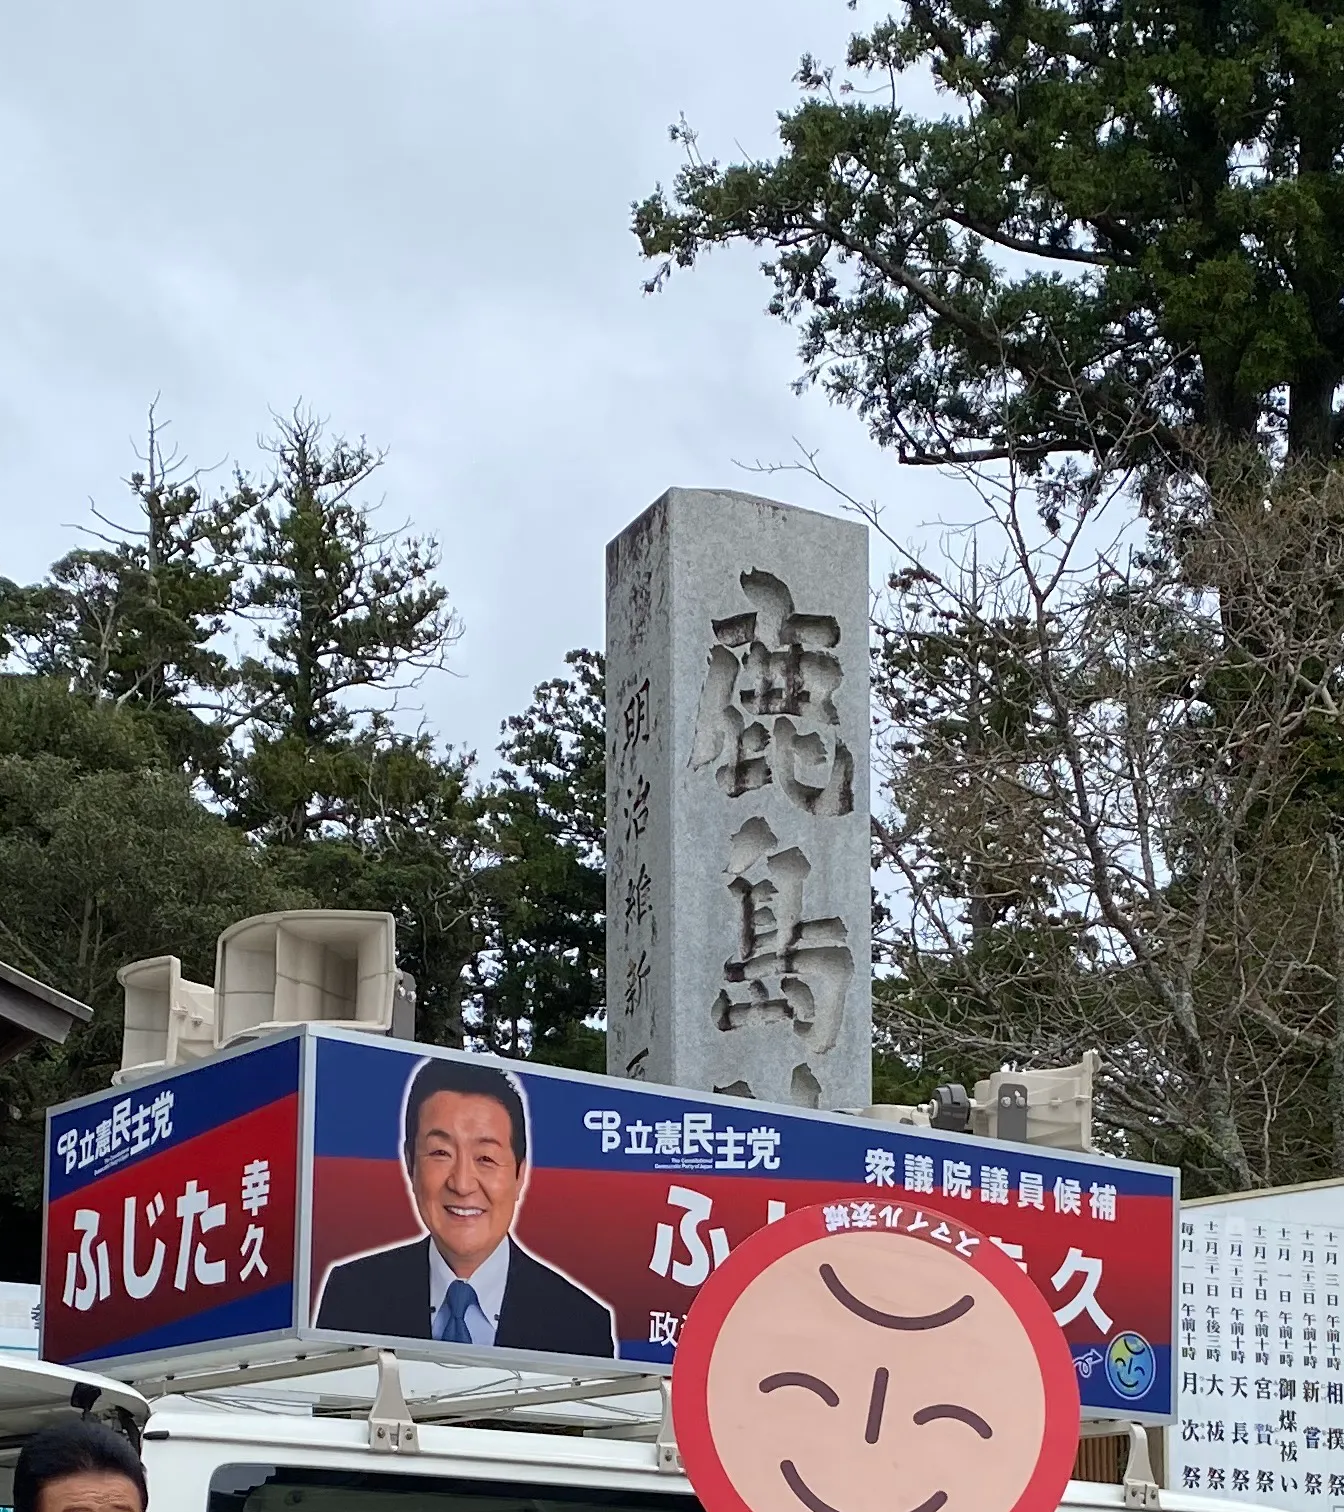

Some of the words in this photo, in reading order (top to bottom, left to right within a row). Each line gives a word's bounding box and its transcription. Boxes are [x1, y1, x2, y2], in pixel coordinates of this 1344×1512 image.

[687, 566, 857, 1104] 鹿島
[78, 1090, 175, 1169] 立憲民主党
[625, 1112, 780, 1170] 立憲民主党
[239, 1159, 271, 1282] 幸久
[864, 1148, 1118, 1221] 衆議院議員候補
[62, 1181, 227, 1312] ふじた
[822, 1201, 981, 1257] スマイル茨城
[1181, 1222, 1195, 1295] 毎月一日
[1253, 1225, 1268, 1301] 十二月二十日
[1276, 1227, 1292, 1303] 十二月一日
[1324, 1231, 1340, 1307] 十一月三日
[649, 1311, 688, 1347] 政
[1181, 1303, 1197, 1361] 午前十時
[1206, 1305, 1221, 1362] 午後三時
[1230, 1307, 1246, 1364] 午前十時
[1255, 1308, 1270, 1366] 午前十時
[1302, 1312, 1318, 1369] 午前十時
[1326, 1314, 1342, 1371] 午前十時
[1182, 1371, 1201, 1489] 月次祭
[1229, 1375, 1250, 1491] 天長祭
